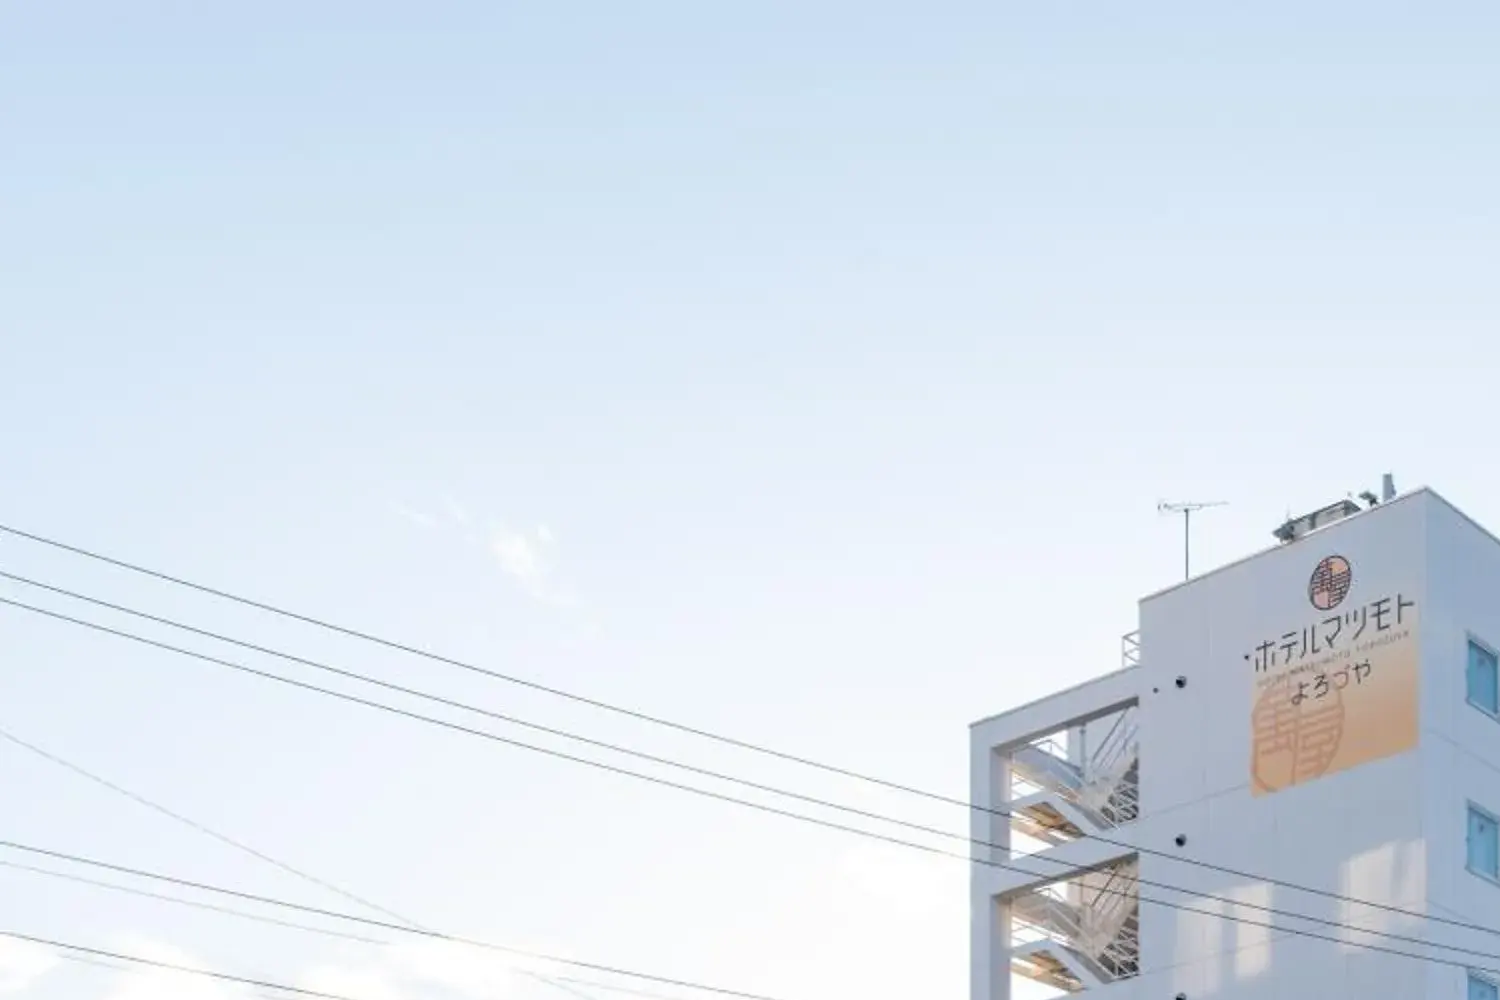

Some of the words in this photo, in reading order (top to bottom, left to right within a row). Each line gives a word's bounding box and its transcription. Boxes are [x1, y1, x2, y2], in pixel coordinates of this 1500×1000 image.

[1255, 594, 1414, 673] ホテルマツモト
[1291, 659, 1371, 705] よろづや
